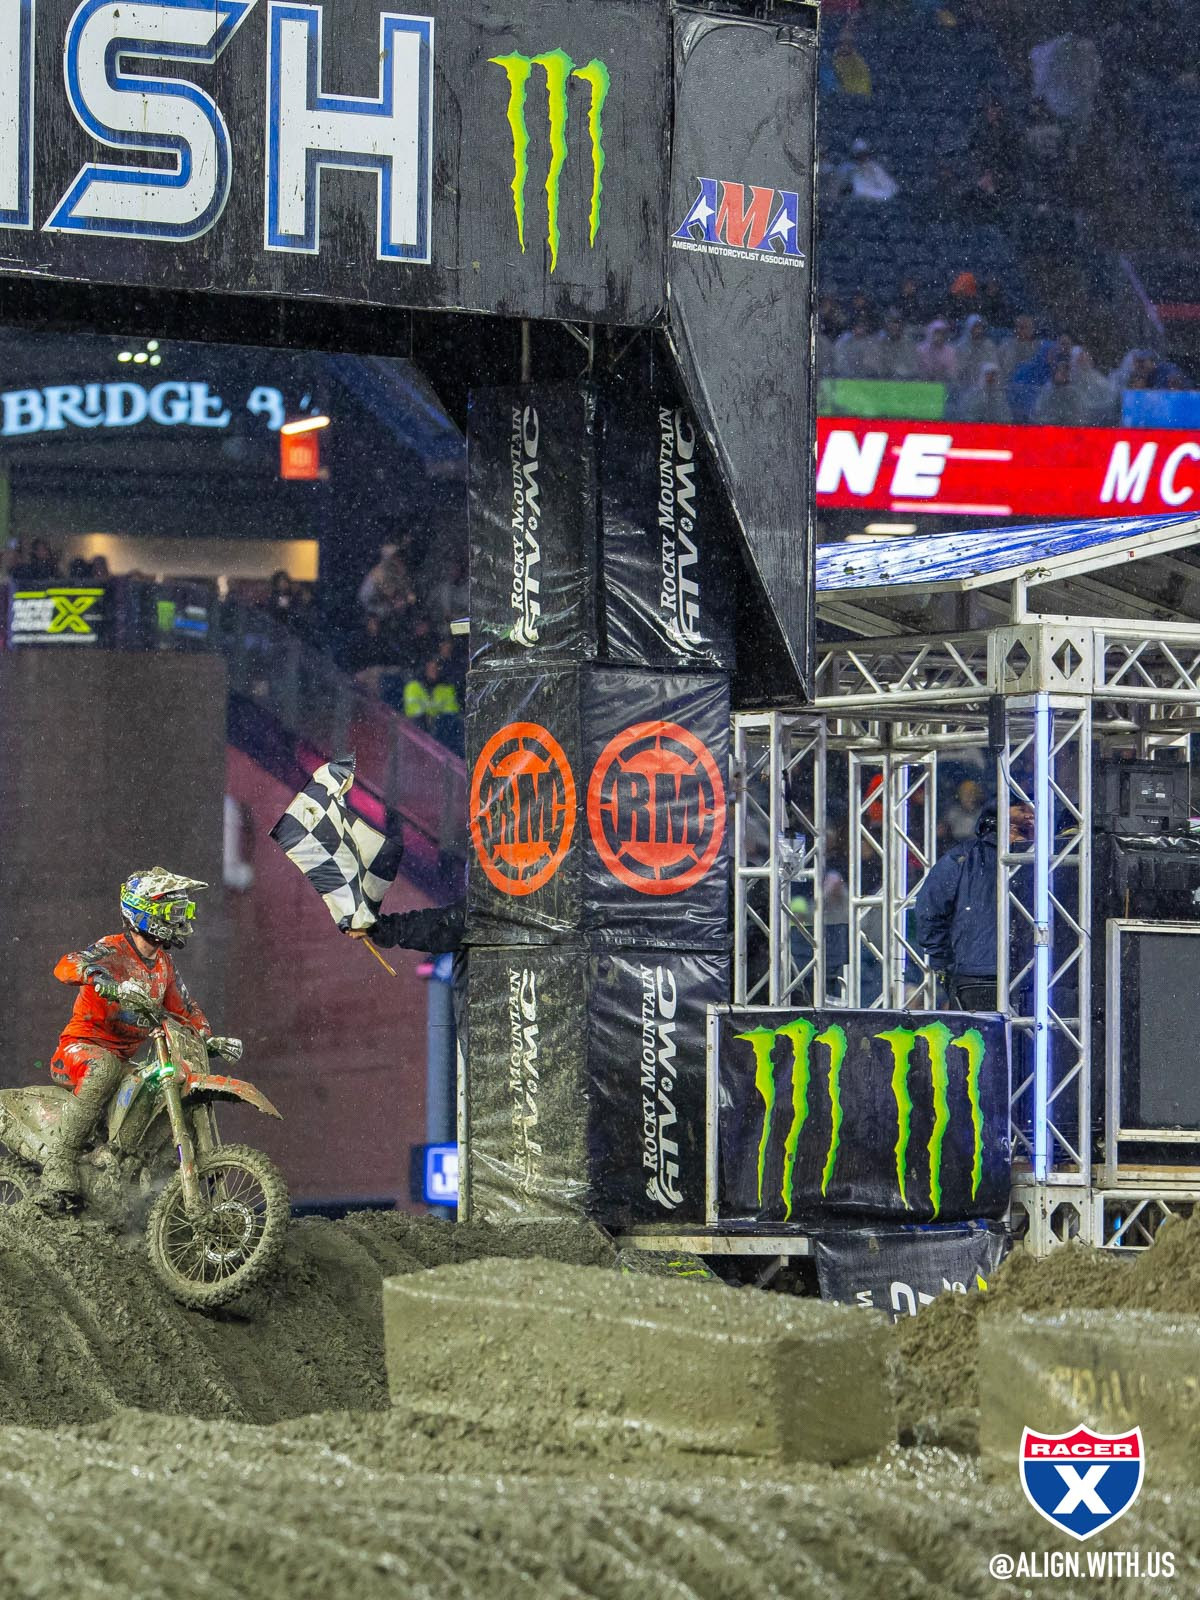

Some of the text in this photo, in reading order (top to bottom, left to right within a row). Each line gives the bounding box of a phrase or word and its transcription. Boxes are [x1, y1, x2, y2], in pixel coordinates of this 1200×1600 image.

[670, 177, 805, 258] AMA
[672, 240, 805, 268] AMERICAN MOTORCYCLIST ASSOCIATION
[0, 381, 231, 436] BRIDGE
[511, 406, 524, 611] ROCKY MOUNTAIN
[658, 405, 676, 612] ROCKY MOUNTAIN
[1099, 440, 1200, 506] MC
[508, 968, 523, 1093] MOUNTAIN
[640, 964, 658, 1170] ROCKY MOUNTAIN
